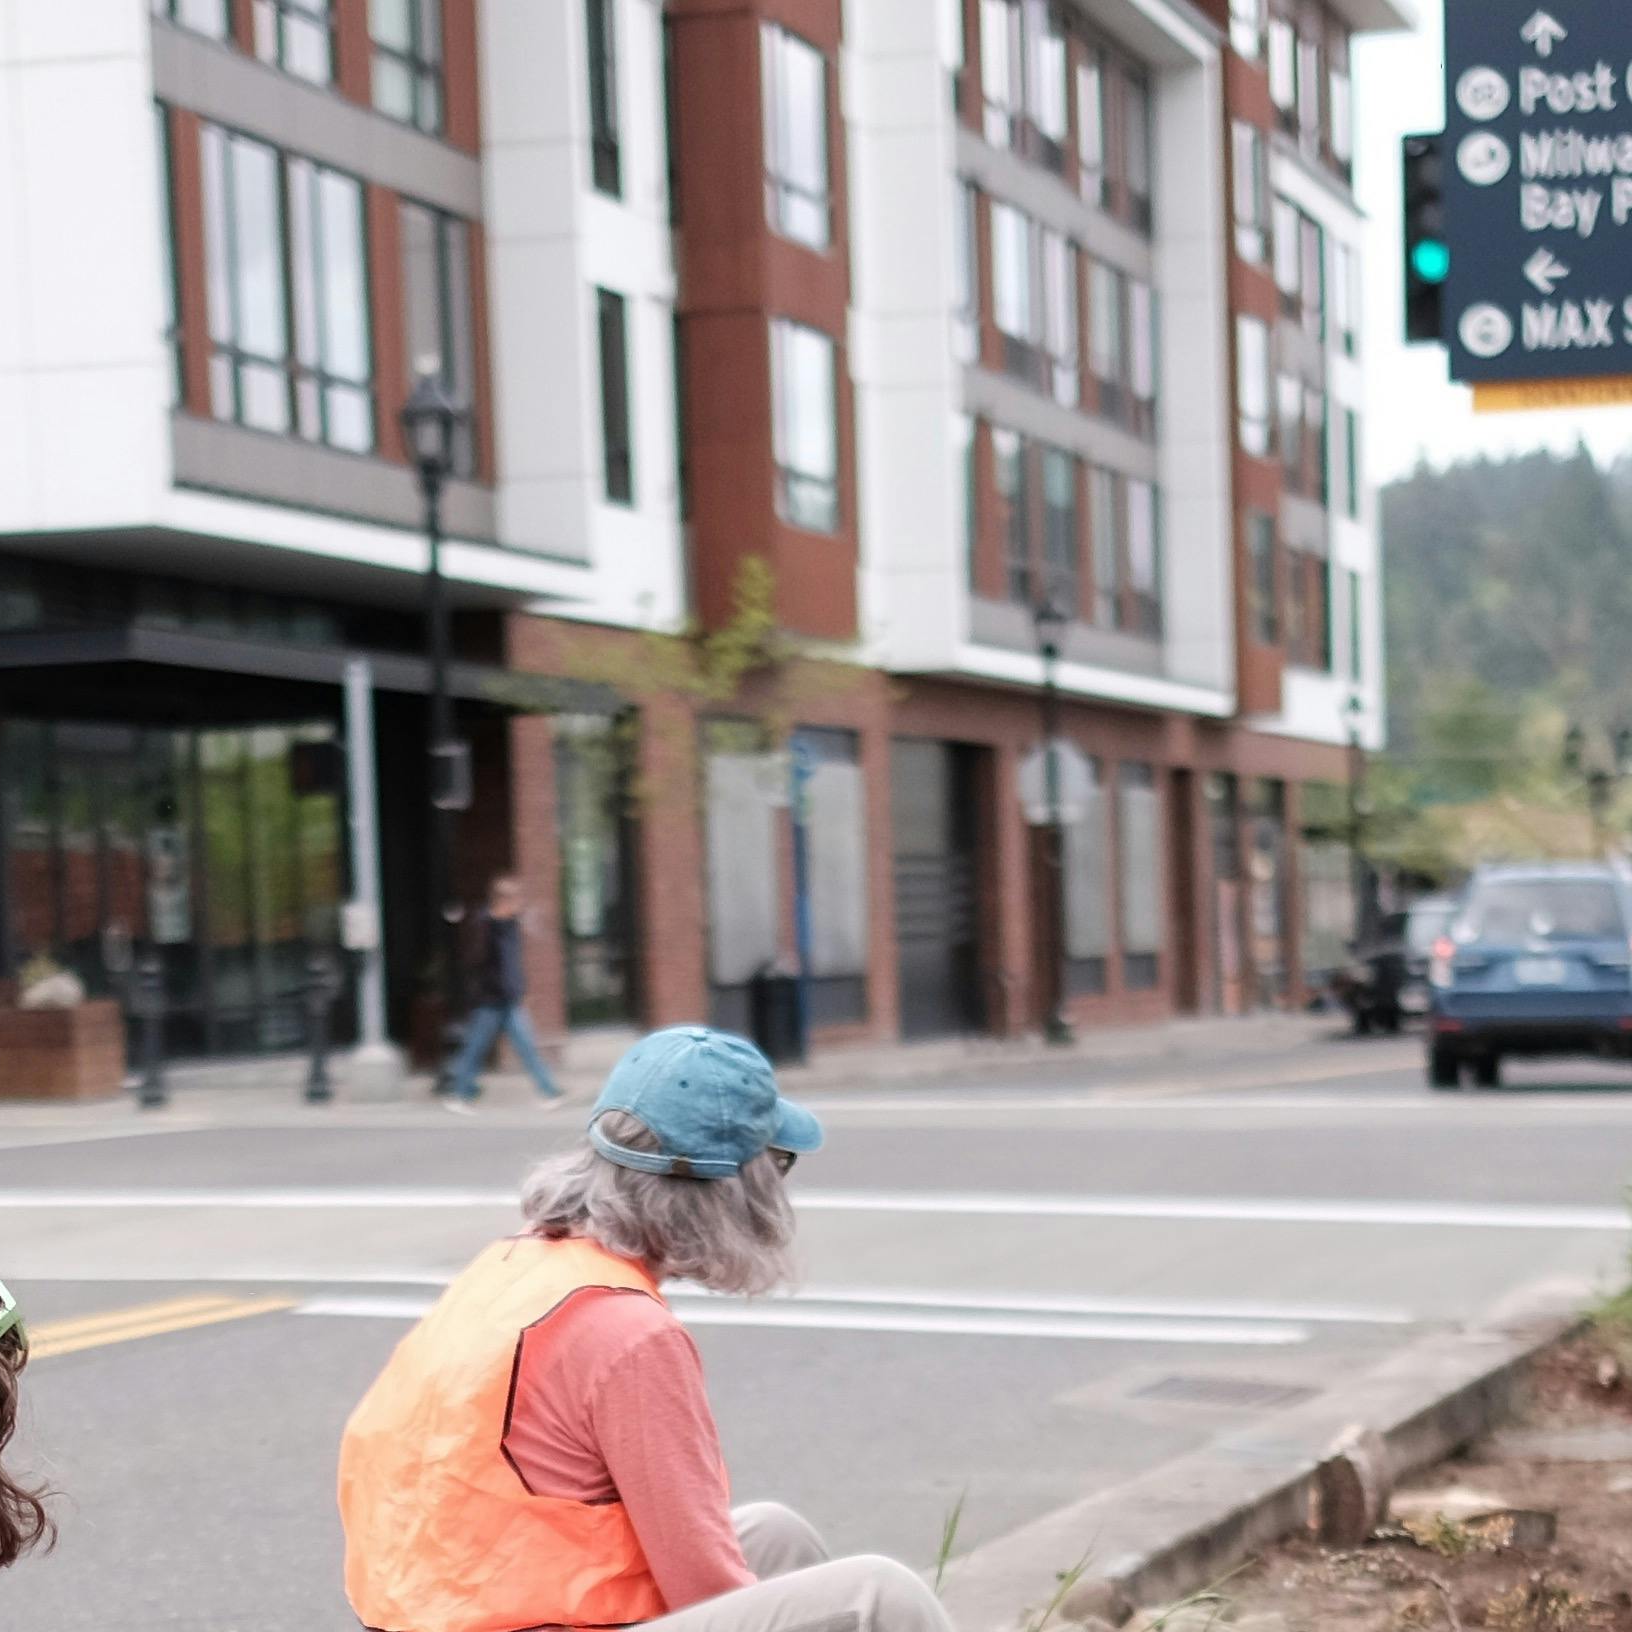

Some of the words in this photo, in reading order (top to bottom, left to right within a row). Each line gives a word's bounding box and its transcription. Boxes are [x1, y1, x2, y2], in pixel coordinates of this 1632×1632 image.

[1519, 61, 1616, 116] Post
[1520, 181, 1603, 237] Bay
[1521, 297, 1614, 351] MAX
